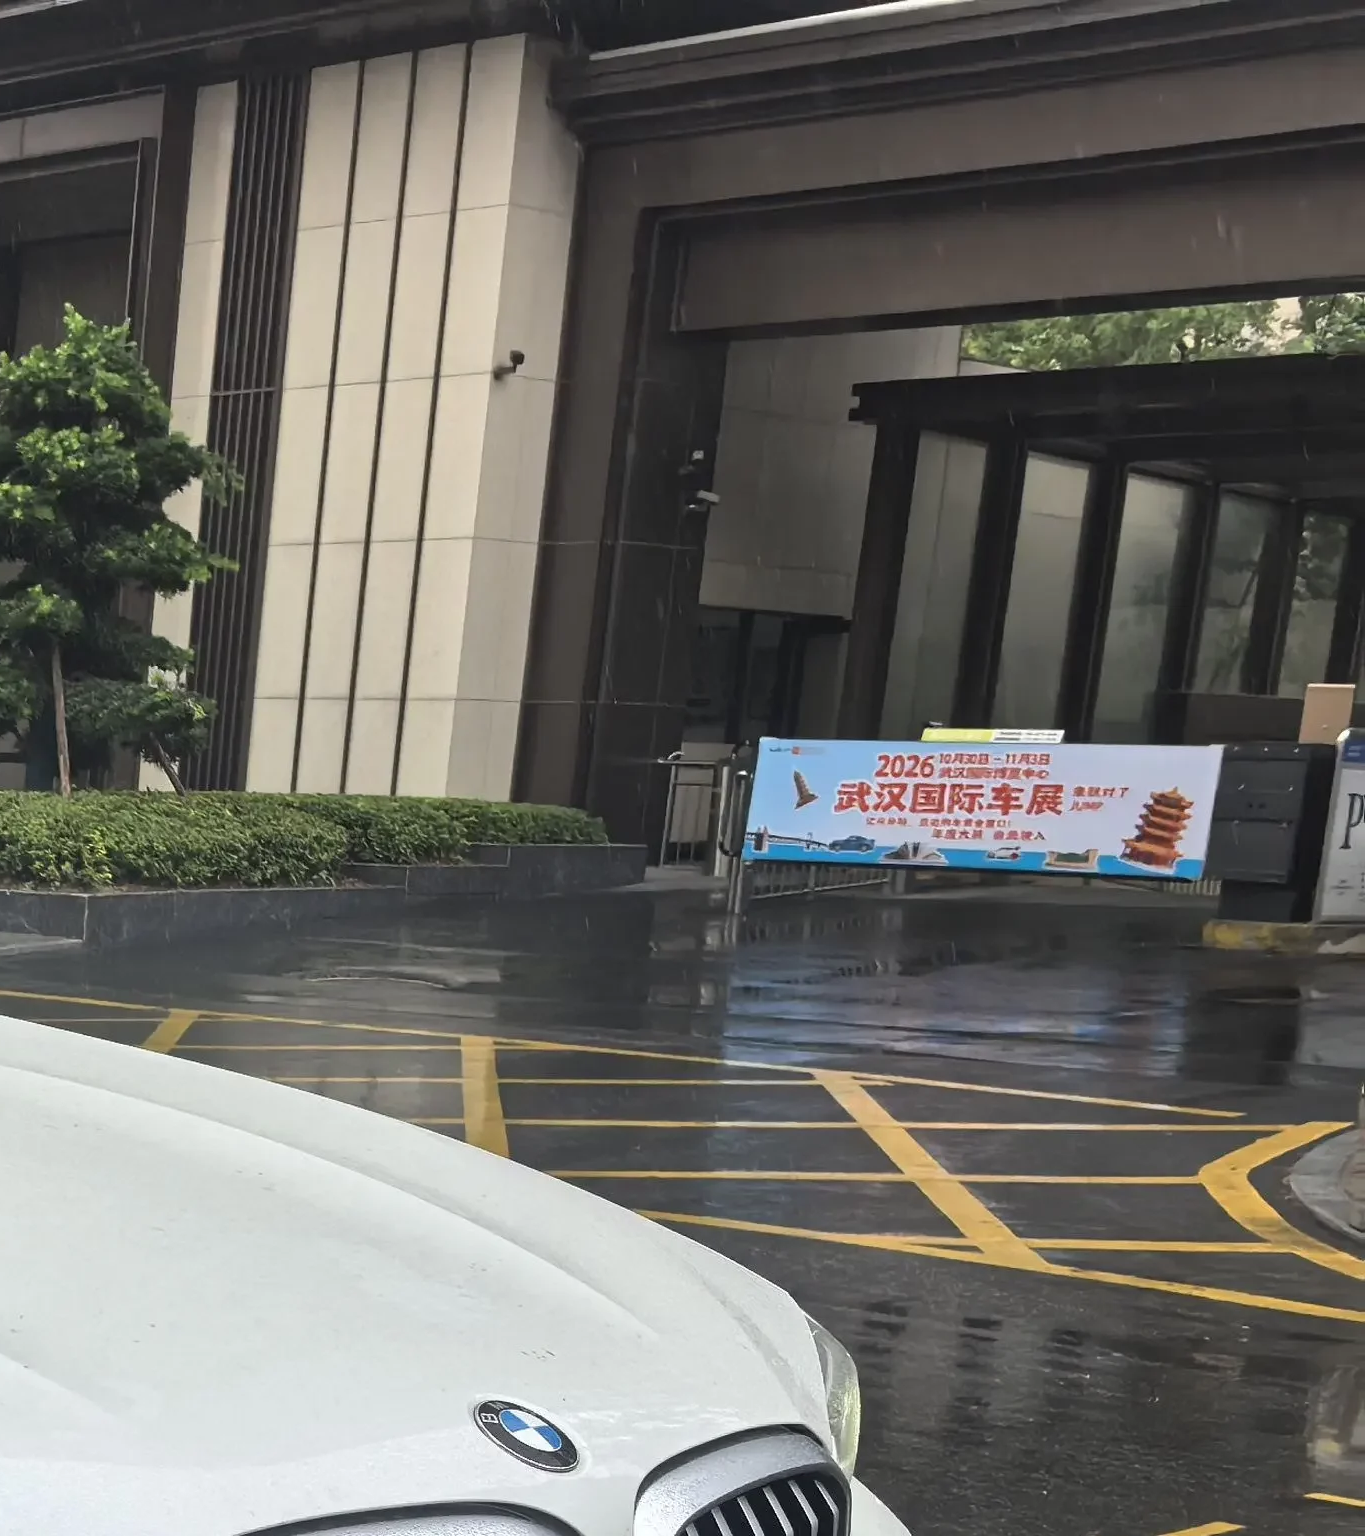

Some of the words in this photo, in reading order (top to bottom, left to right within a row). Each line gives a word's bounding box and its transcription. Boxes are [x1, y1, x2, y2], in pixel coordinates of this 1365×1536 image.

[875, 754, 935, 778] 2026
[833, 782, 1065, 816] 武汉国际车展
